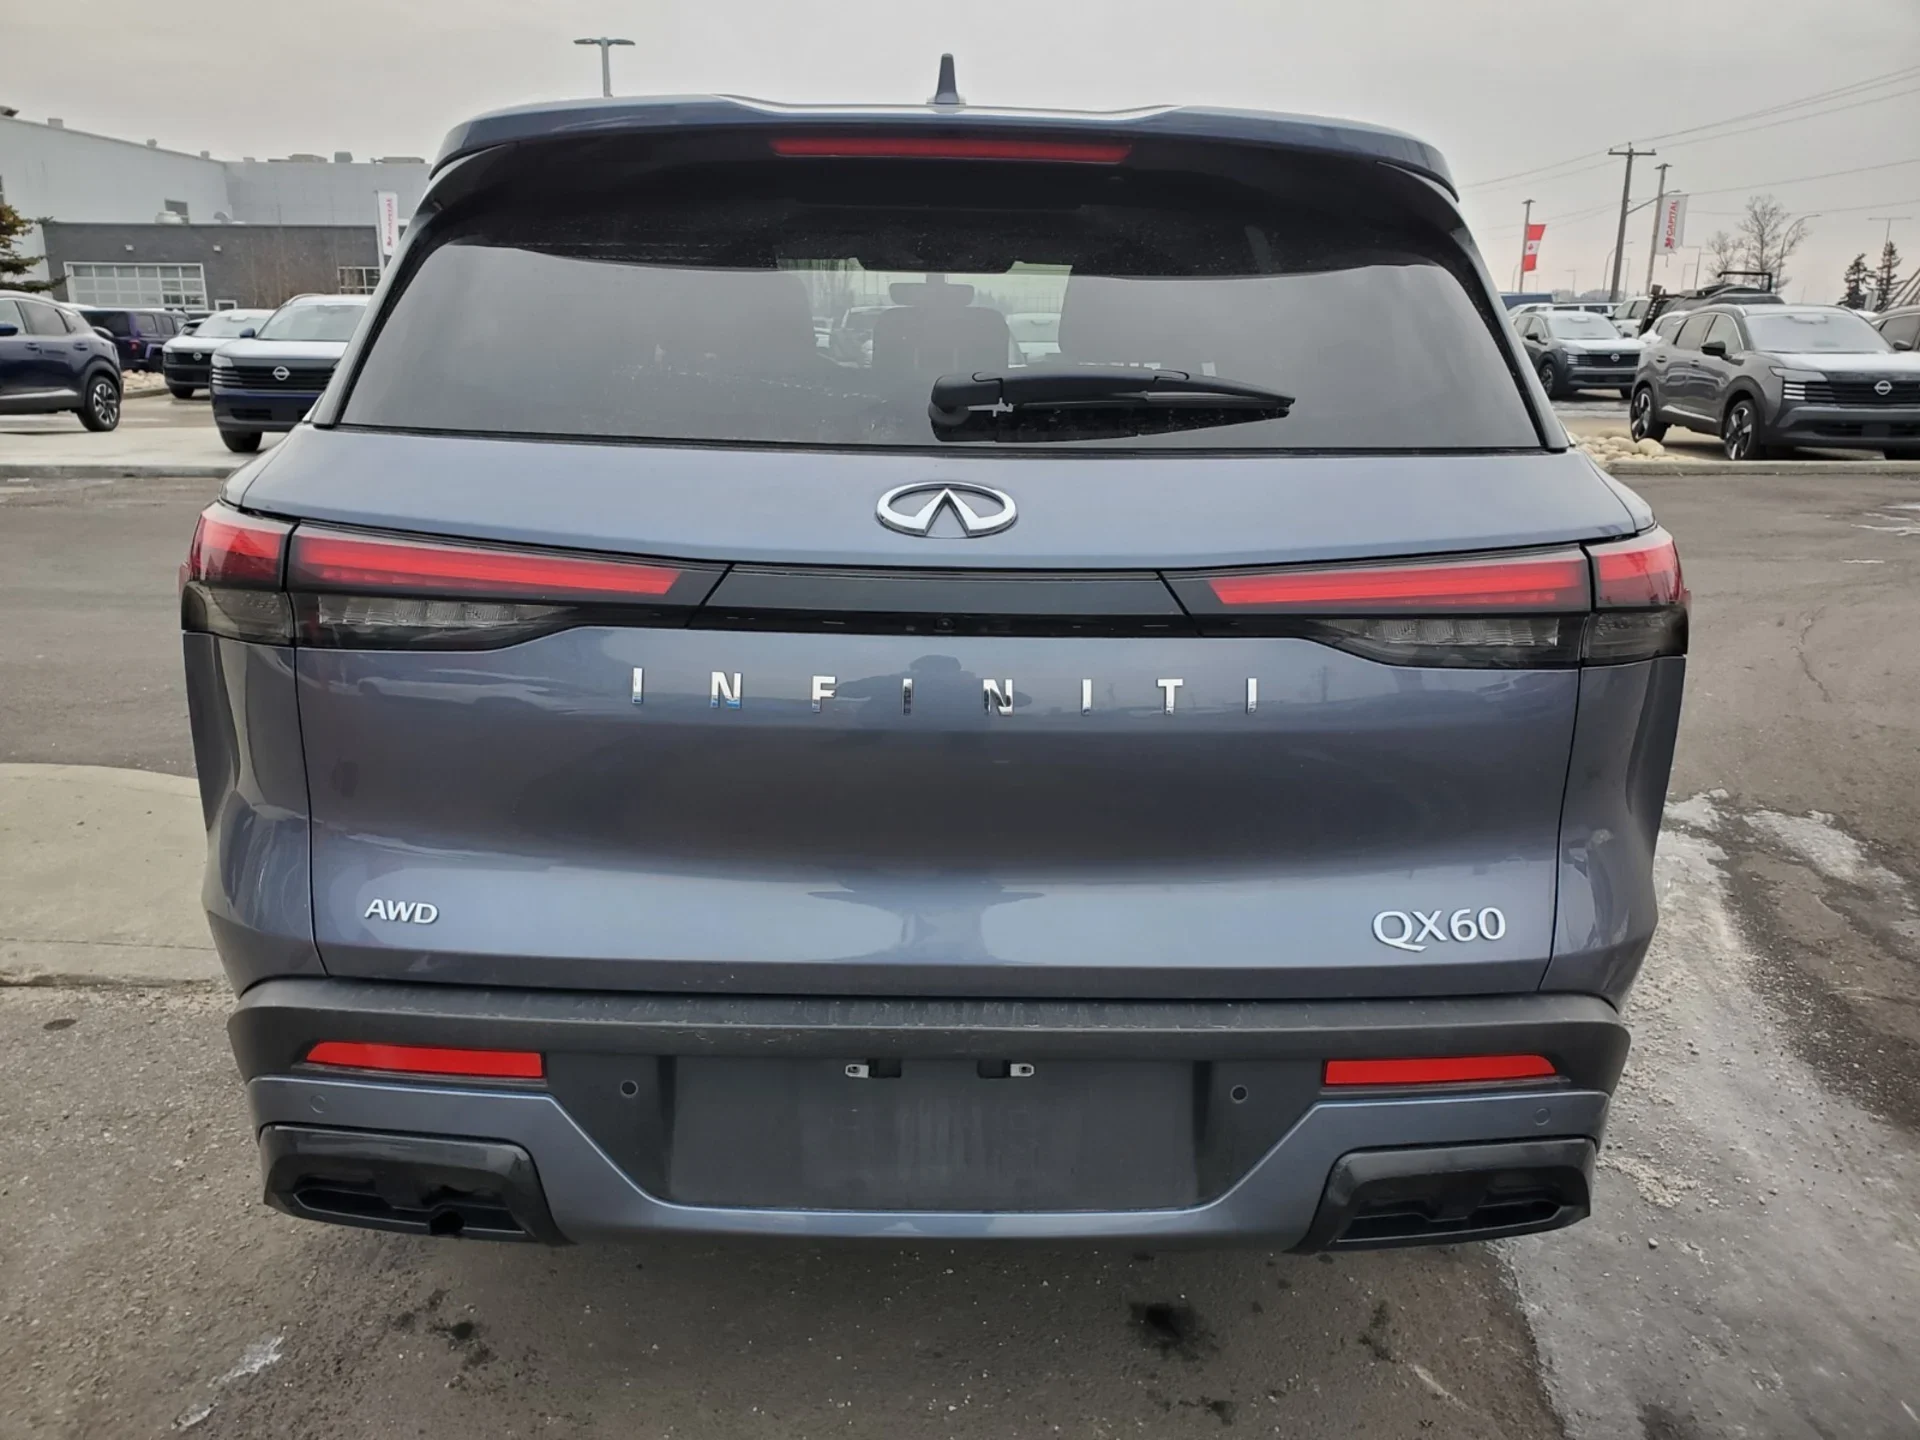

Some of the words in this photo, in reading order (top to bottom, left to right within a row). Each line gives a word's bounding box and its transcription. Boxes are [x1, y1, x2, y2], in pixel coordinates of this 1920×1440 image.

[1666, 200, 1678, 236] CAPITAL
[631, 666, 1258, 715] INFINITI
[364, 898, 438, 923] AWD
[1372, 906, 1506, 952] QX60
